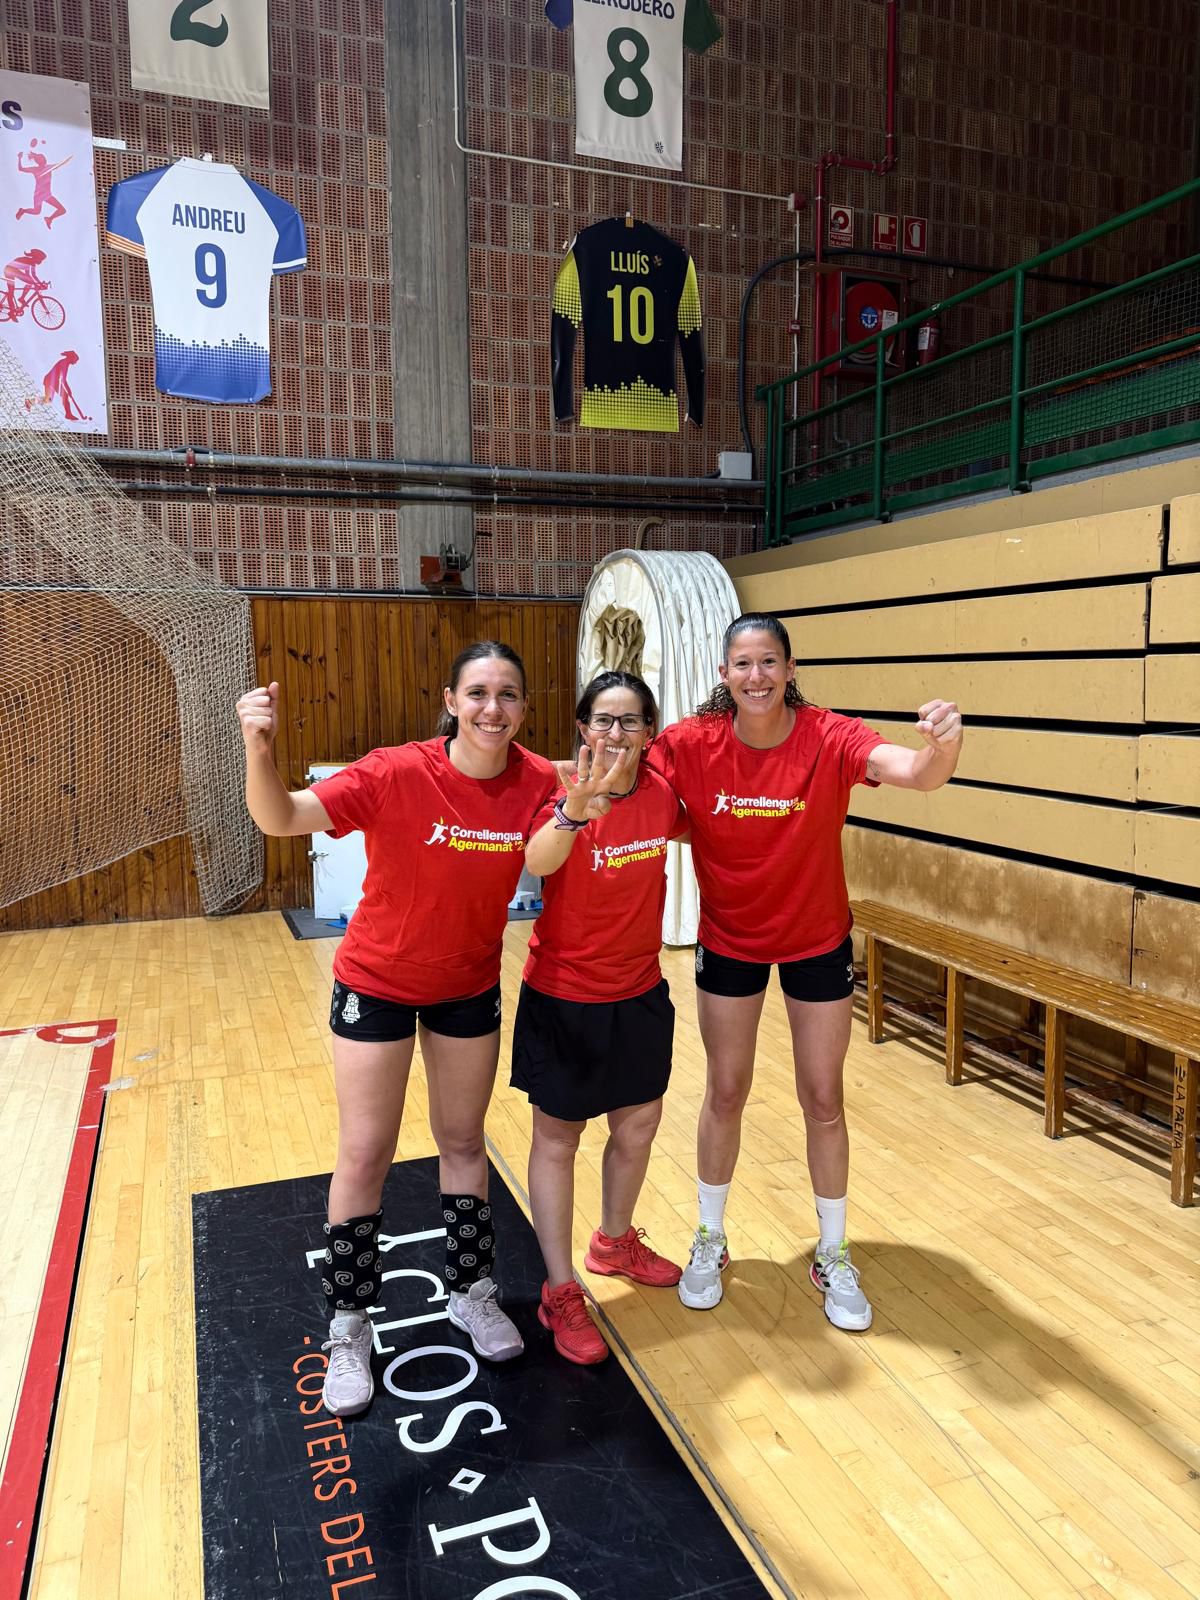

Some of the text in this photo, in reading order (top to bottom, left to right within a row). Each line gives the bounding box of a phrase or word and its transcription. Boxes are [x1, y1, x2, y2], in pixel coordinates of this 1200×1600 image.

[603, 26, 654, 118] 8
[172, 203, 246, 234] ANDREU
[194, 243, 227, 308] 9
[610, 250, 650, 275] LLUÍS
[607, 284, 655, 345] 10
[730, 806, 791, 818] Agermanat
[448, 837, 513, 852] Agermanat
[450, 825, 523, 843] Correllengua
[604, 836, 666, 857] Correllengua
[607, 846, 661, 868] Agermanat
[1173, 1084, 1186, 1149] LA PAERIA
[366, 1268, 508, 1453] CLOS
[292, 1352, 377, 1600] COSTERS DEL
